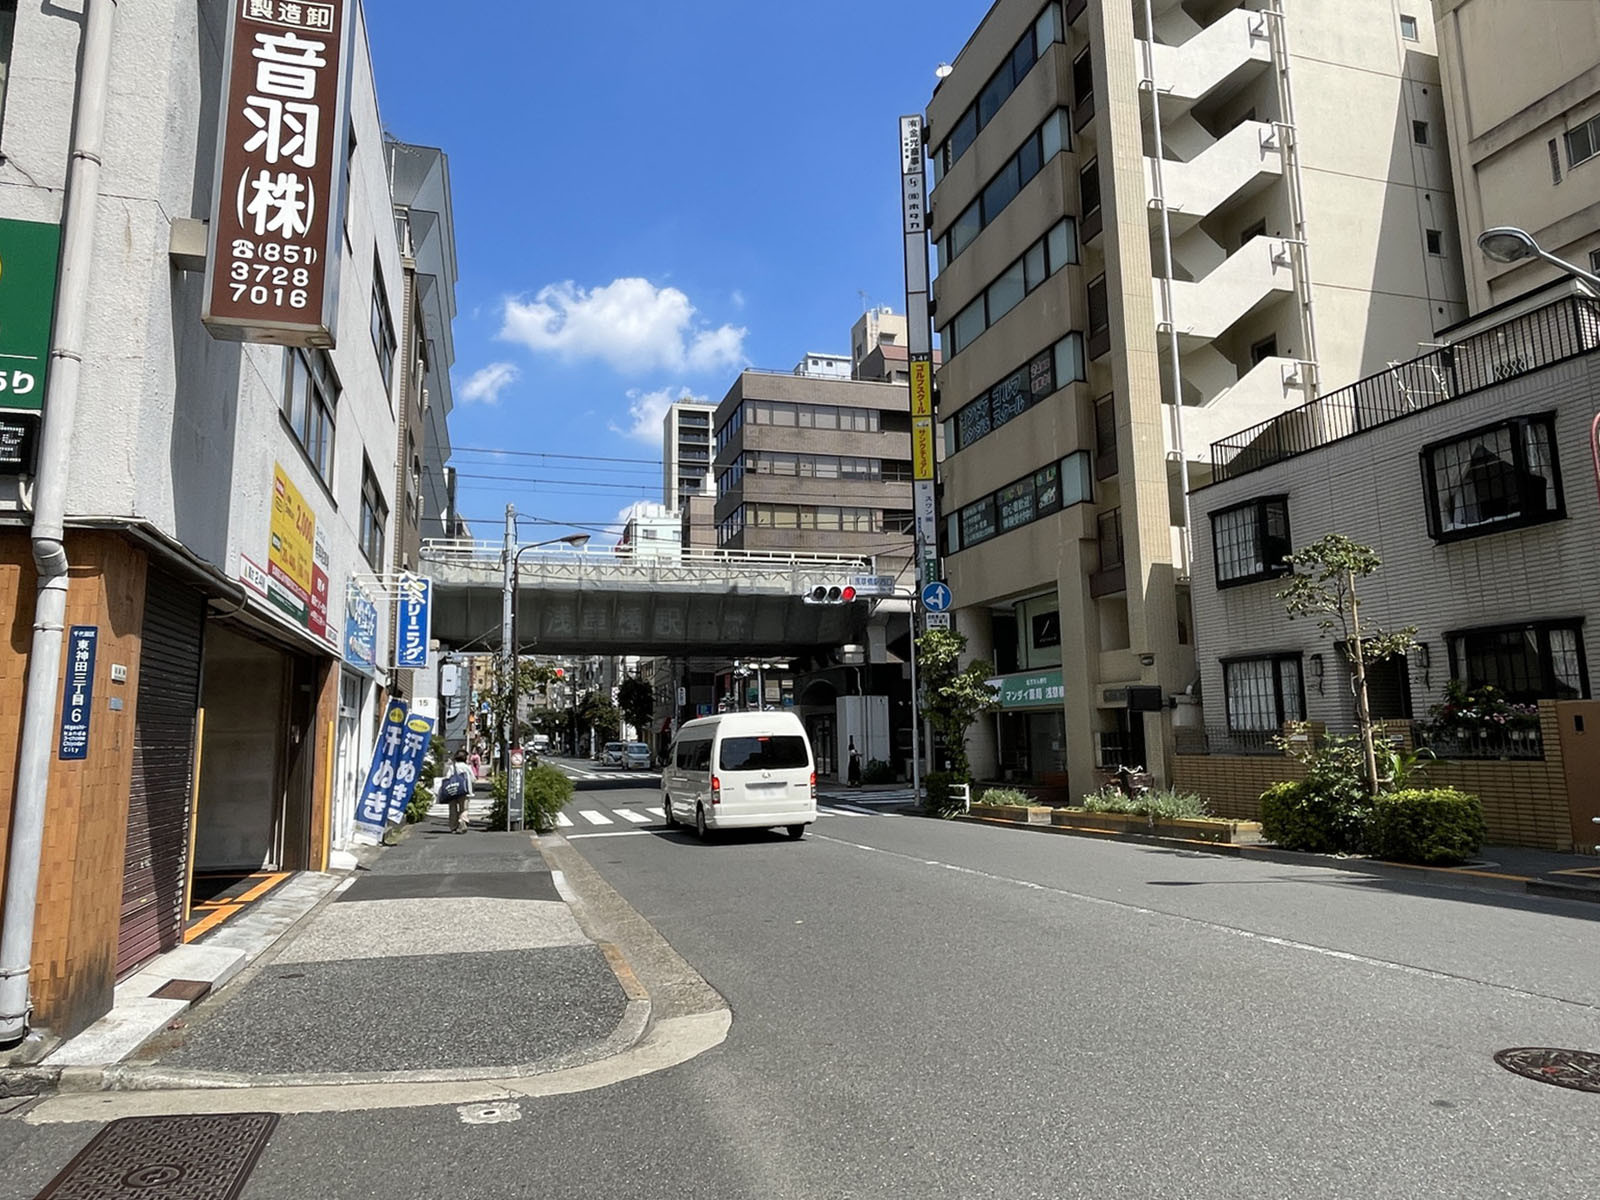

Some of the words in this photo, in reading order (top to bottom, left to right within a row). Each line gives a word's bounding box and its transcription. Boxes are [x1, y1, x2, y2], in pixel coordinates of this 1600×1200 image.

[250, 0, 329, 27] 製造卸
[257, 244, 318, 266] (851)
[230, 263, 310, 288] 3728
[229, 284, 308, 308] 7016
[915, 364, 926, 414] ゴルフスクール
